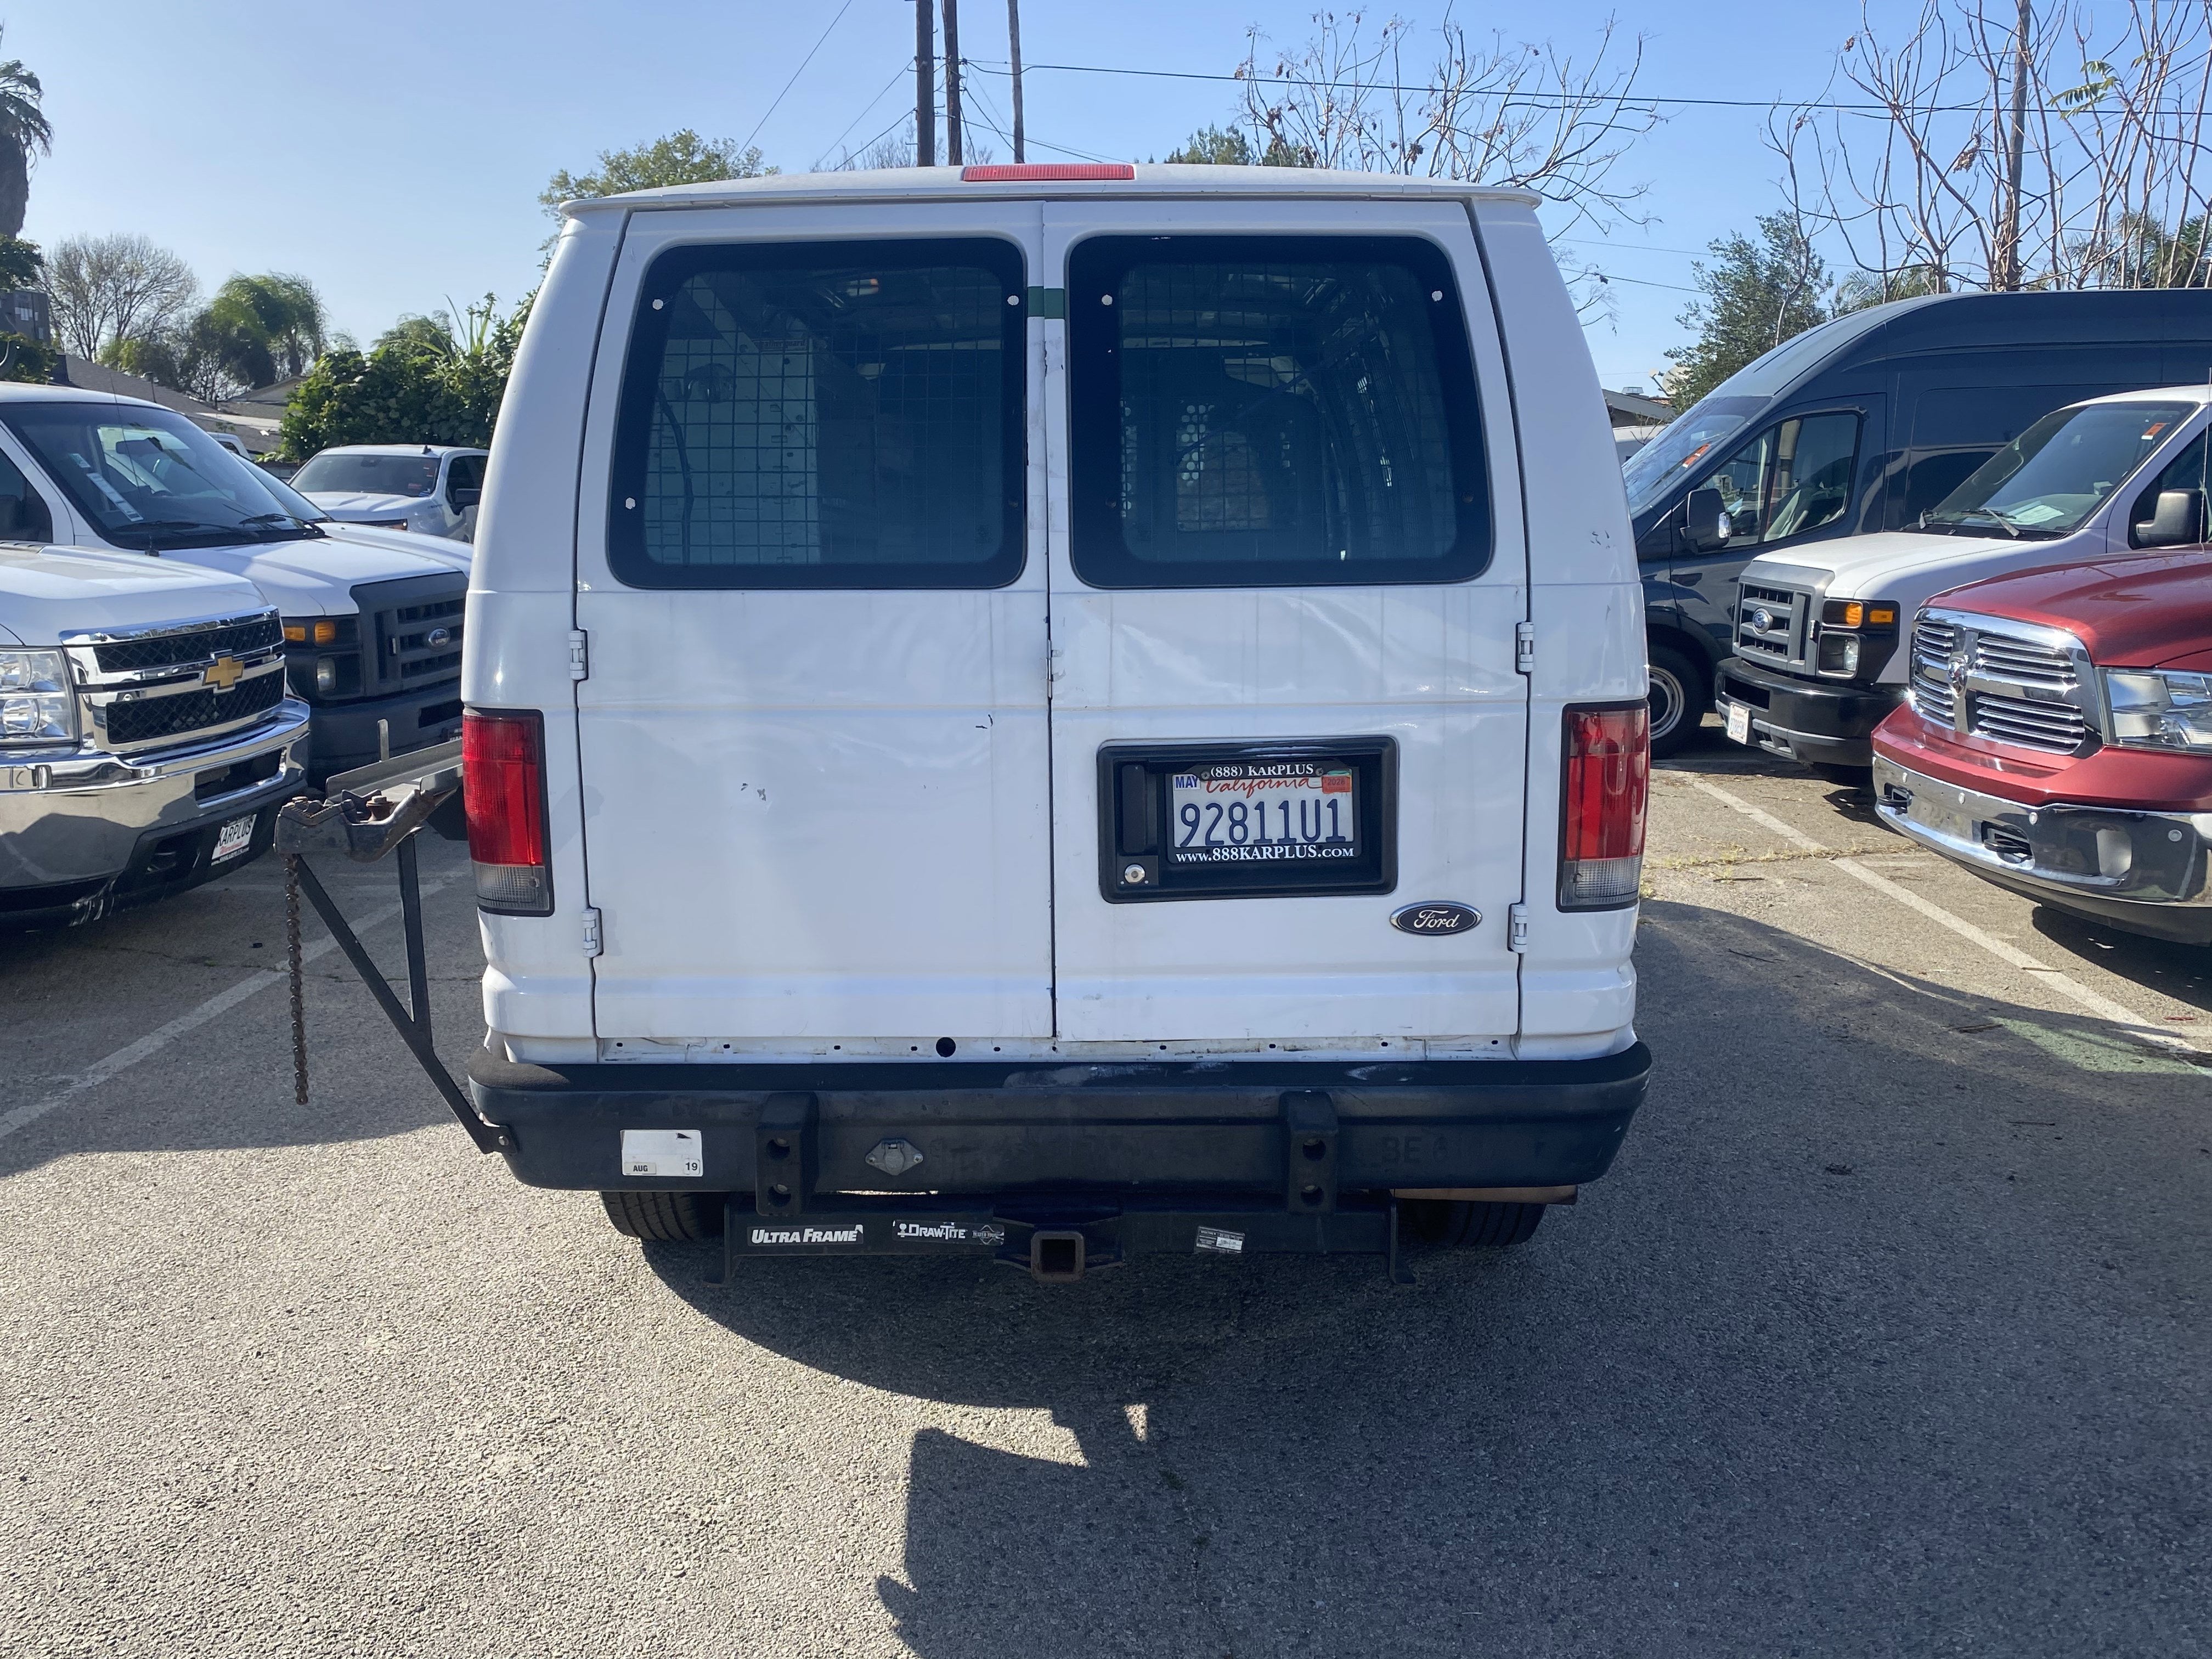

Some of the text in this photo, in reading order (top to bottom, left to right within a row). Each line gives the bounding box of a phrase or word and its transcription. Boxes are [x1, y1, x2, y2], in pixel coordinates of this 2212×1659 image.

[1211, 764, 1313, 777] (888) KARPLUS
[1175, 776, 1198, 788] MAY
[1206, 777, 1322, 799] California
[1180, 798, 1346, 848] 92811U1
[216, 819, 252, 848] KARPLUS
[1413, 910, 1460, 928] Ford
[686, 1162, 698, 1171] 19
[752, 1228, 857, 1243] ULTRA FRAME
